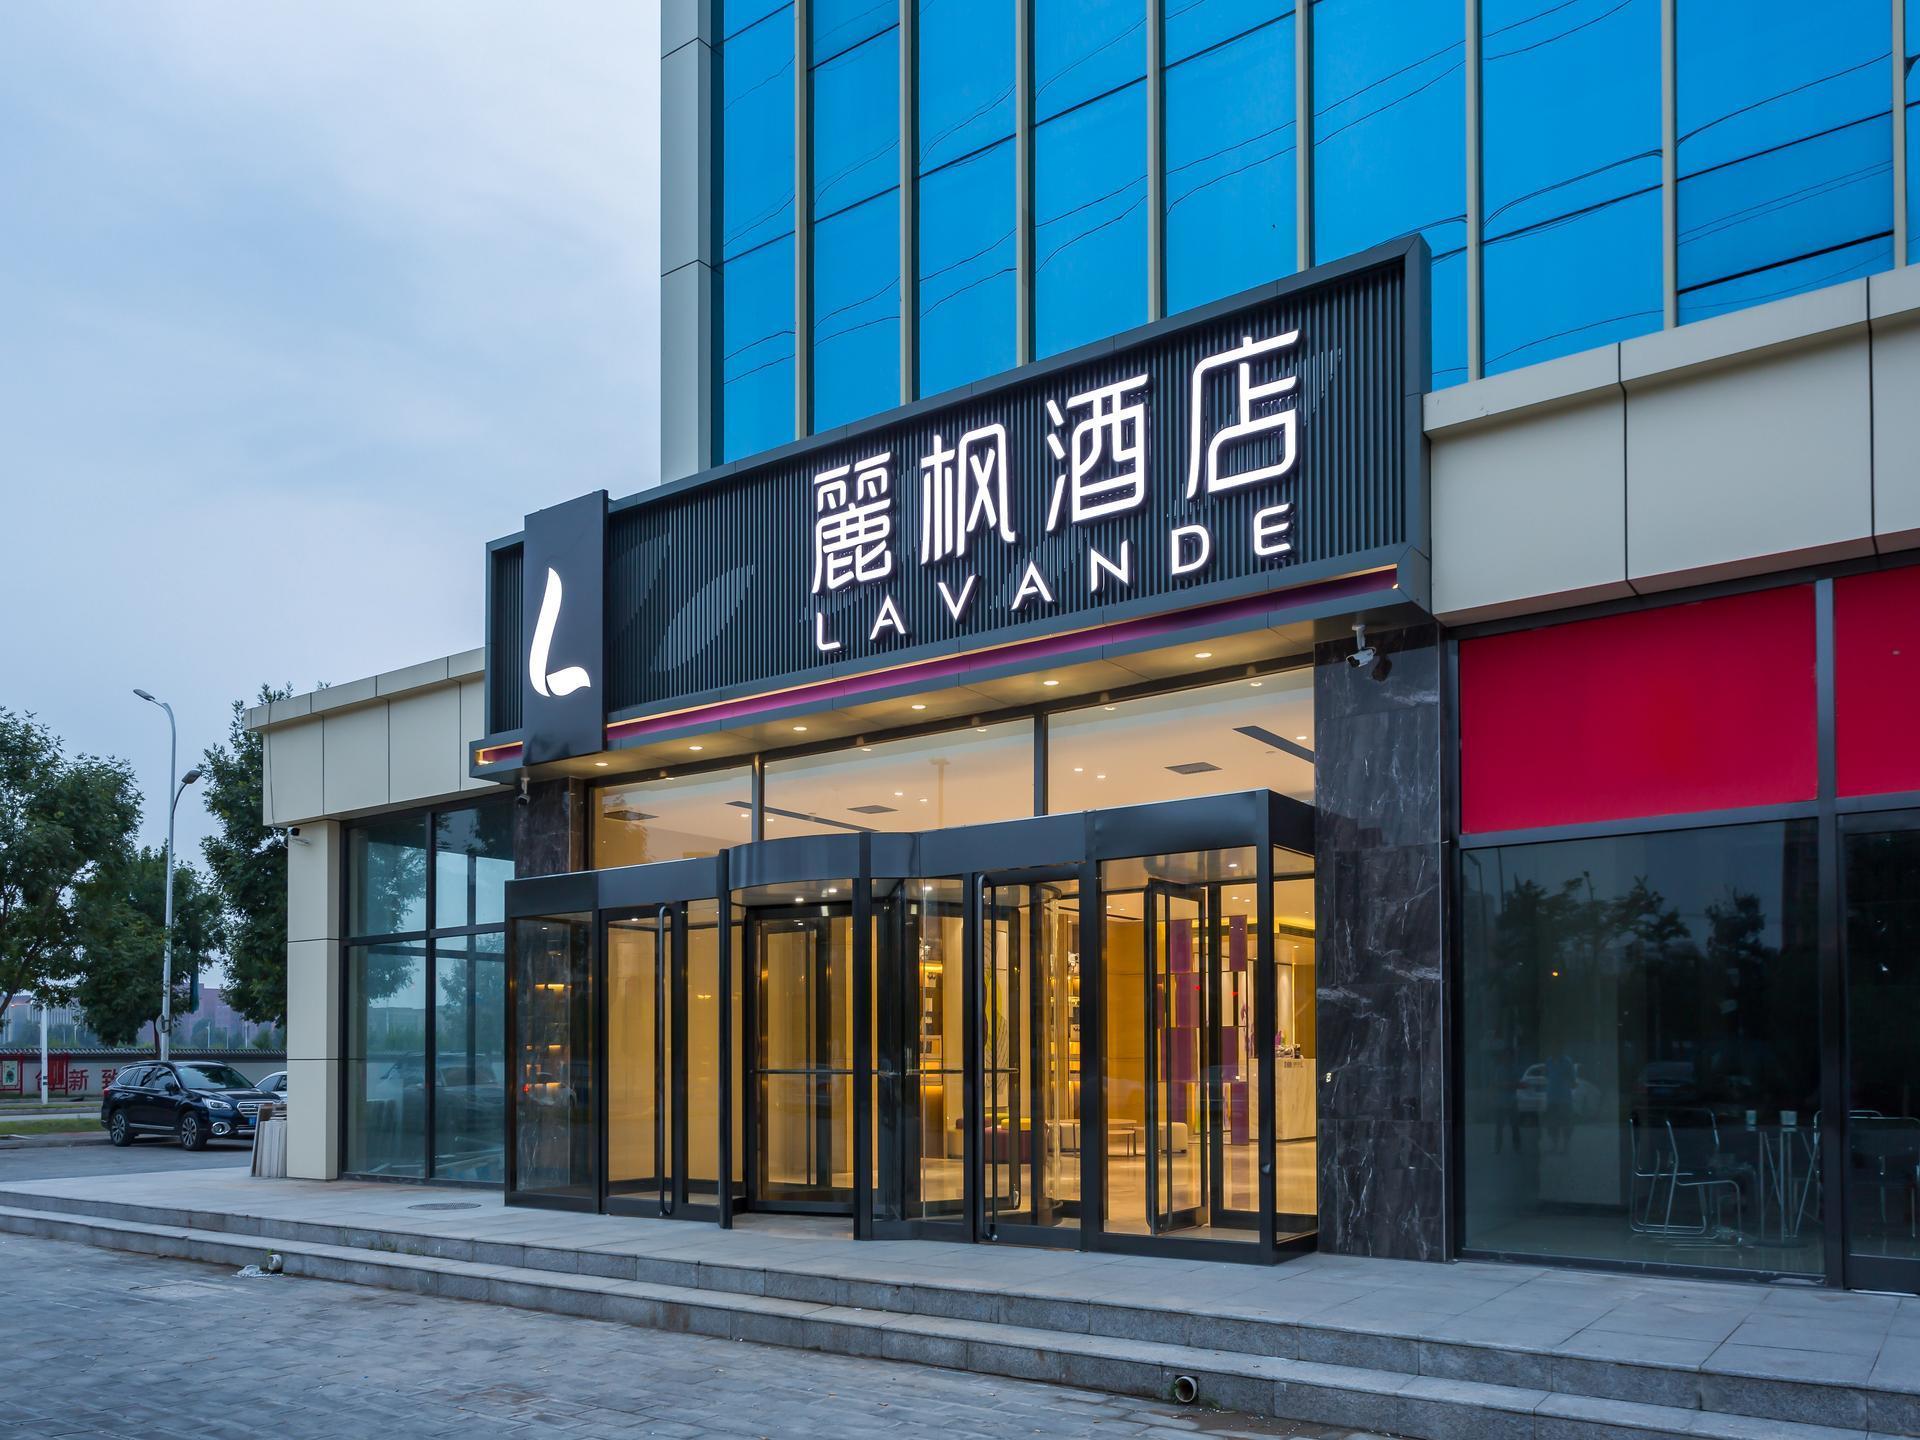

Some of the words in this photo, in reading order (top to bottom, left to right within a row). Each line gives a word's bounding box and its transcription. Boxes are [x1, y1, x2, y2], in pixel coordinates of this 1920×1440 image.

[811, 330, 1300, 594] 麗枫酒店
[816, 503, 1292, 651] LAVANDE
